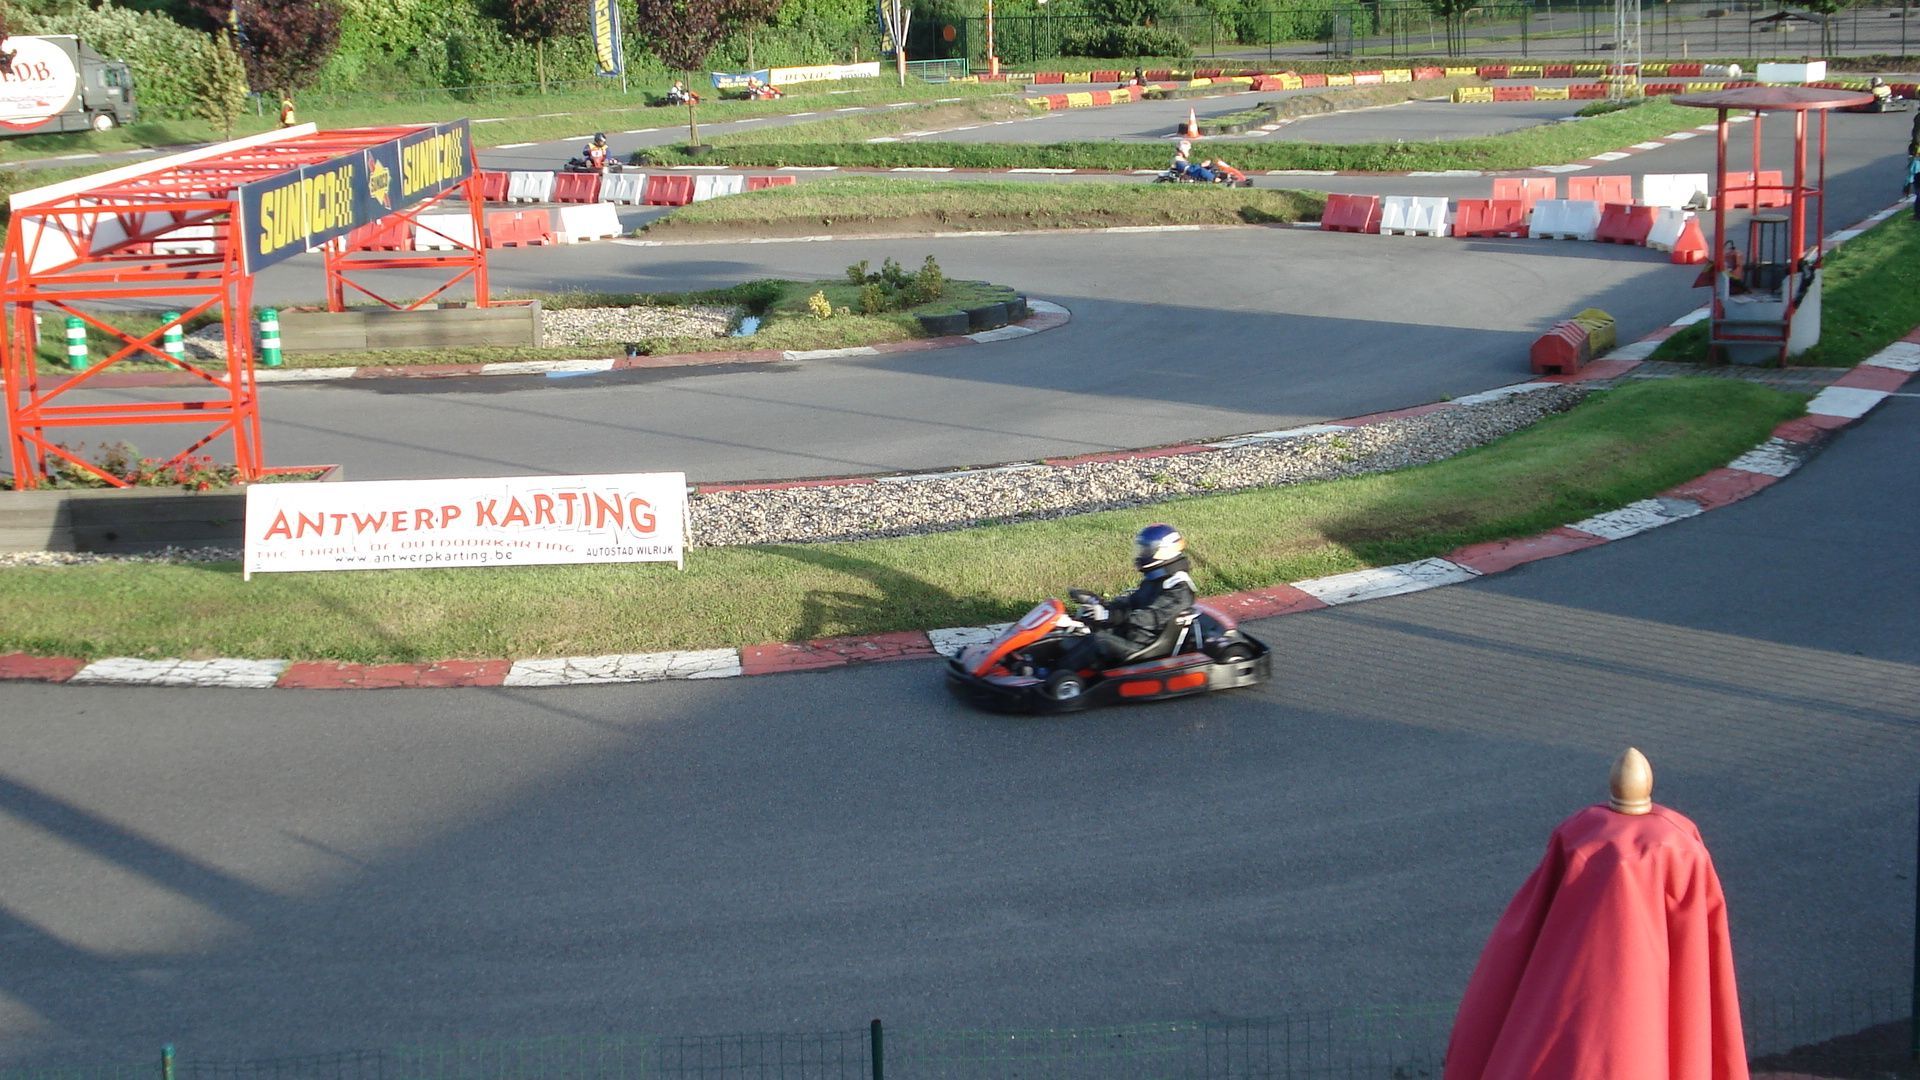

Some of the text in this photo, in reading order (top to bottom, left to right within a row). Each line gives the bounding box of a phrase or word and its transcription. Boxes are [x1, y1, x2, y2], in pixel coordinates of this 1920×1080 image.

[2, 61, 56, 82] .D.B.
[403, 132, 452, 196] SUNOCO
[260, 171, 336, 255] SUNOCO
[263, 492, 656, 540] ANTWERP KARTING
[586, 545, 674, 557] AUTOSTAD WILRIJK
